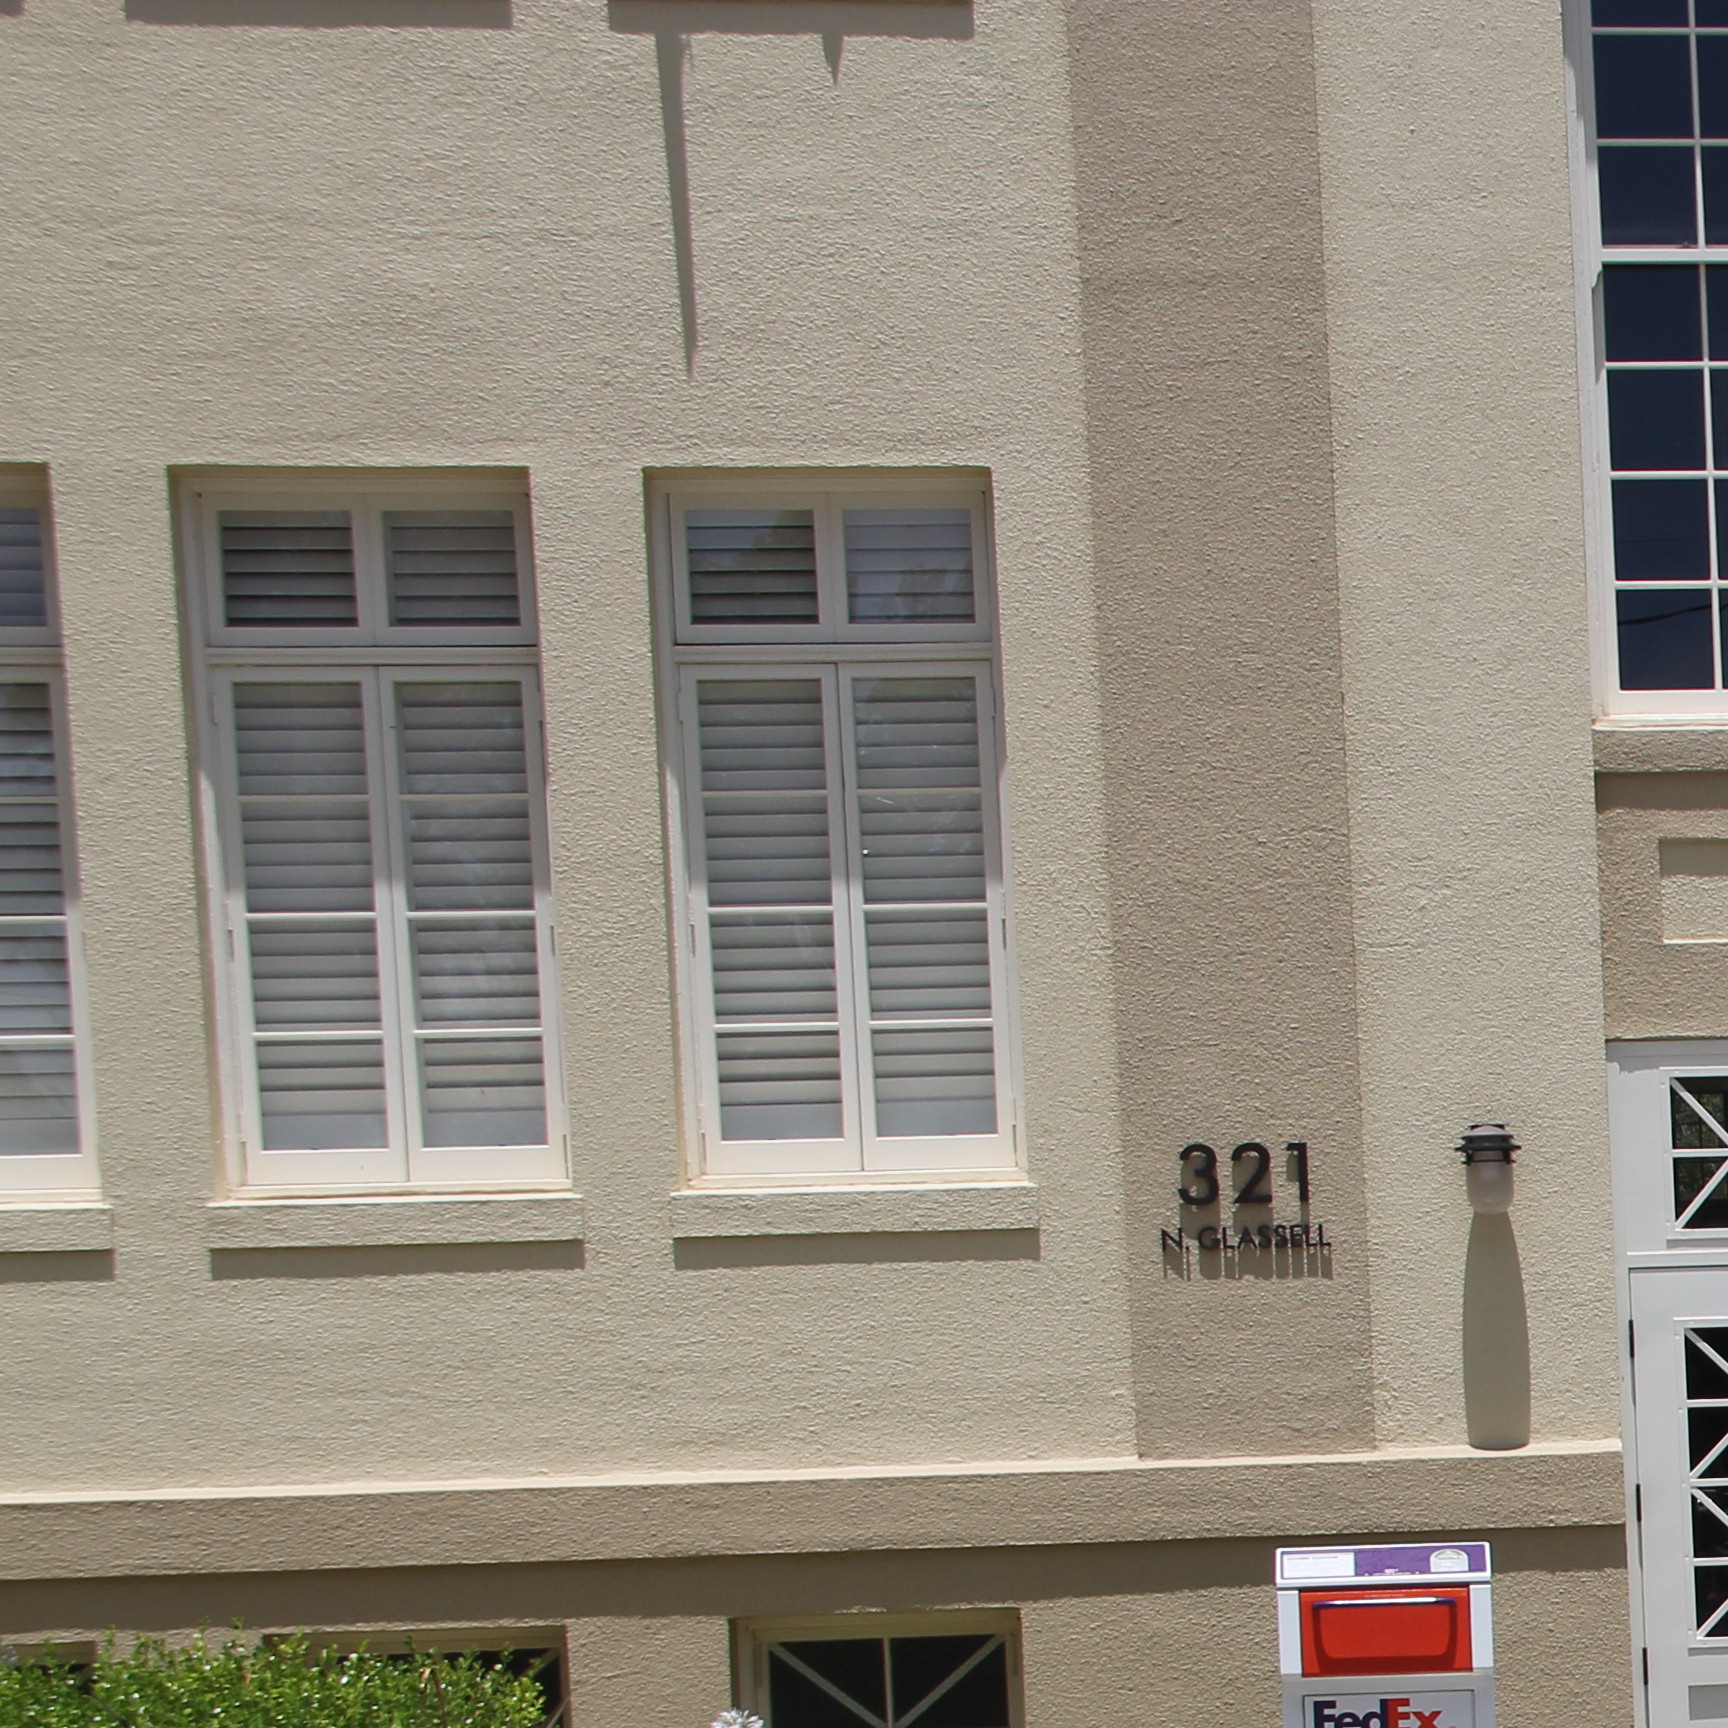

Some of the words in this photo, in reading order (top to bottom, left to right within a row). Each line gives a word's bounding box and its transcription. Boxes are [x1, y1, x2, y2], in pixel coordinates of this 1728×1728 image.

[1177, 1142, 1310, 1206] 321
[1160, 1227, 1191, 1252] N.
[1197, 1222, 1333, 1251] GLASSELL
